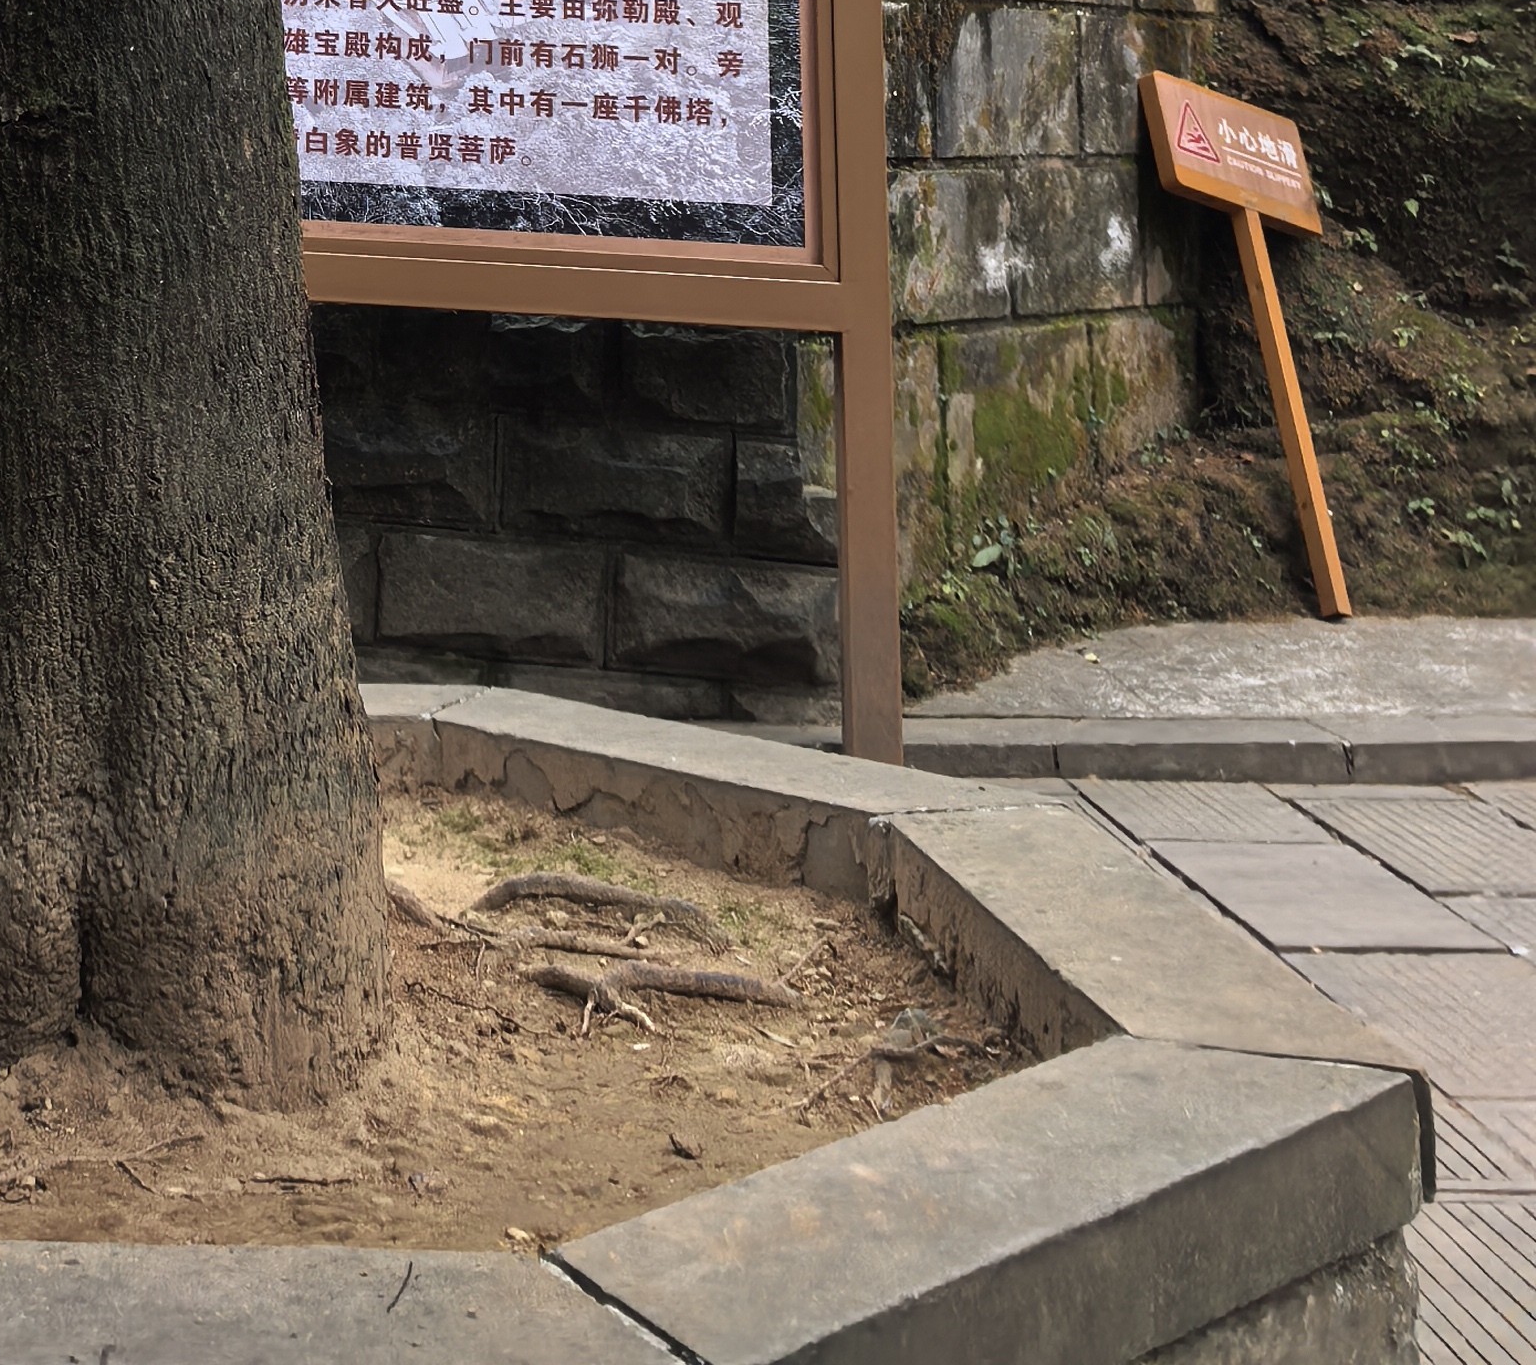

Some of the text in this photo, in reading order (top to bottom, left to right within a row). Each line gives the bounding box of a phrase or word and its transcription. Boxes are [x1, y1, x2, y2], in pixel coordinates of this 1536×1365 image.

[294, 127, 532, 166] 白象的普贤菩萨。
[1218, 118, 1298, 169] 小心地滑
